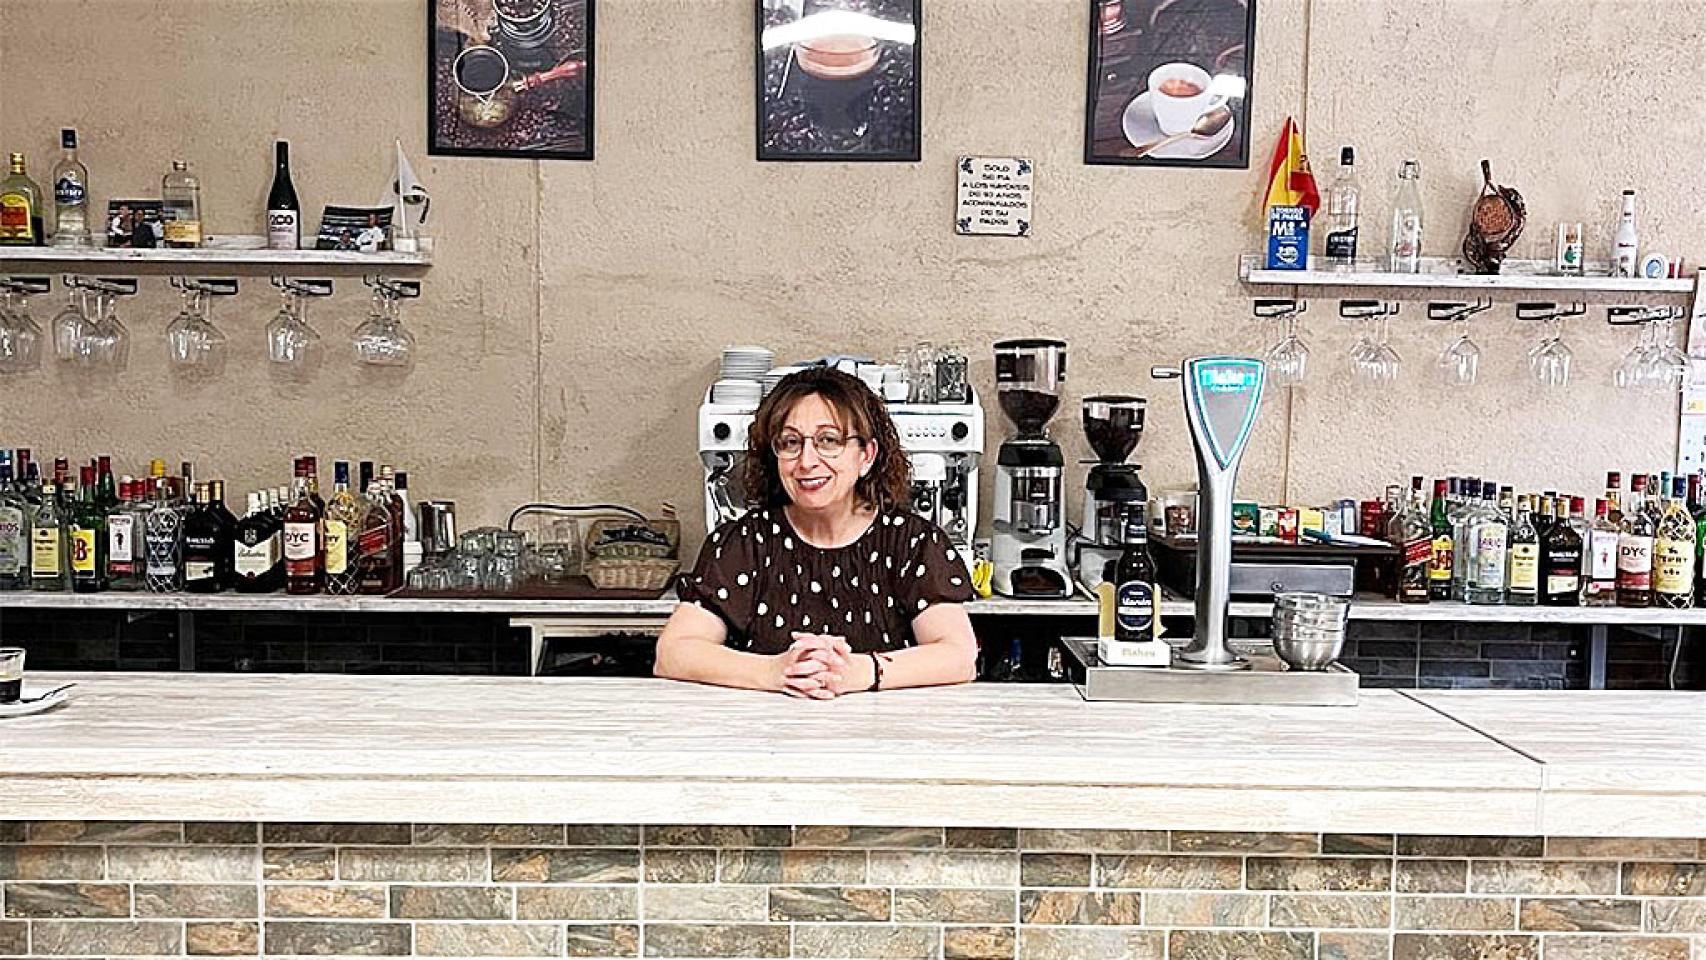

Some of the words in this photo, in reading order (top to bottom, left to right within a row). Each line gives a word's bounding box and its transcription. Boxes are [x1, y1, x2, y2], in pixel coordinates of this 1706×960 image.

[984, 164, 1010, 172] SOLO
[990, 183, 1030, 191] MAYORES
[285, 532, 309, 543] DYC
[1621, 546, 1648, 558] DYC
